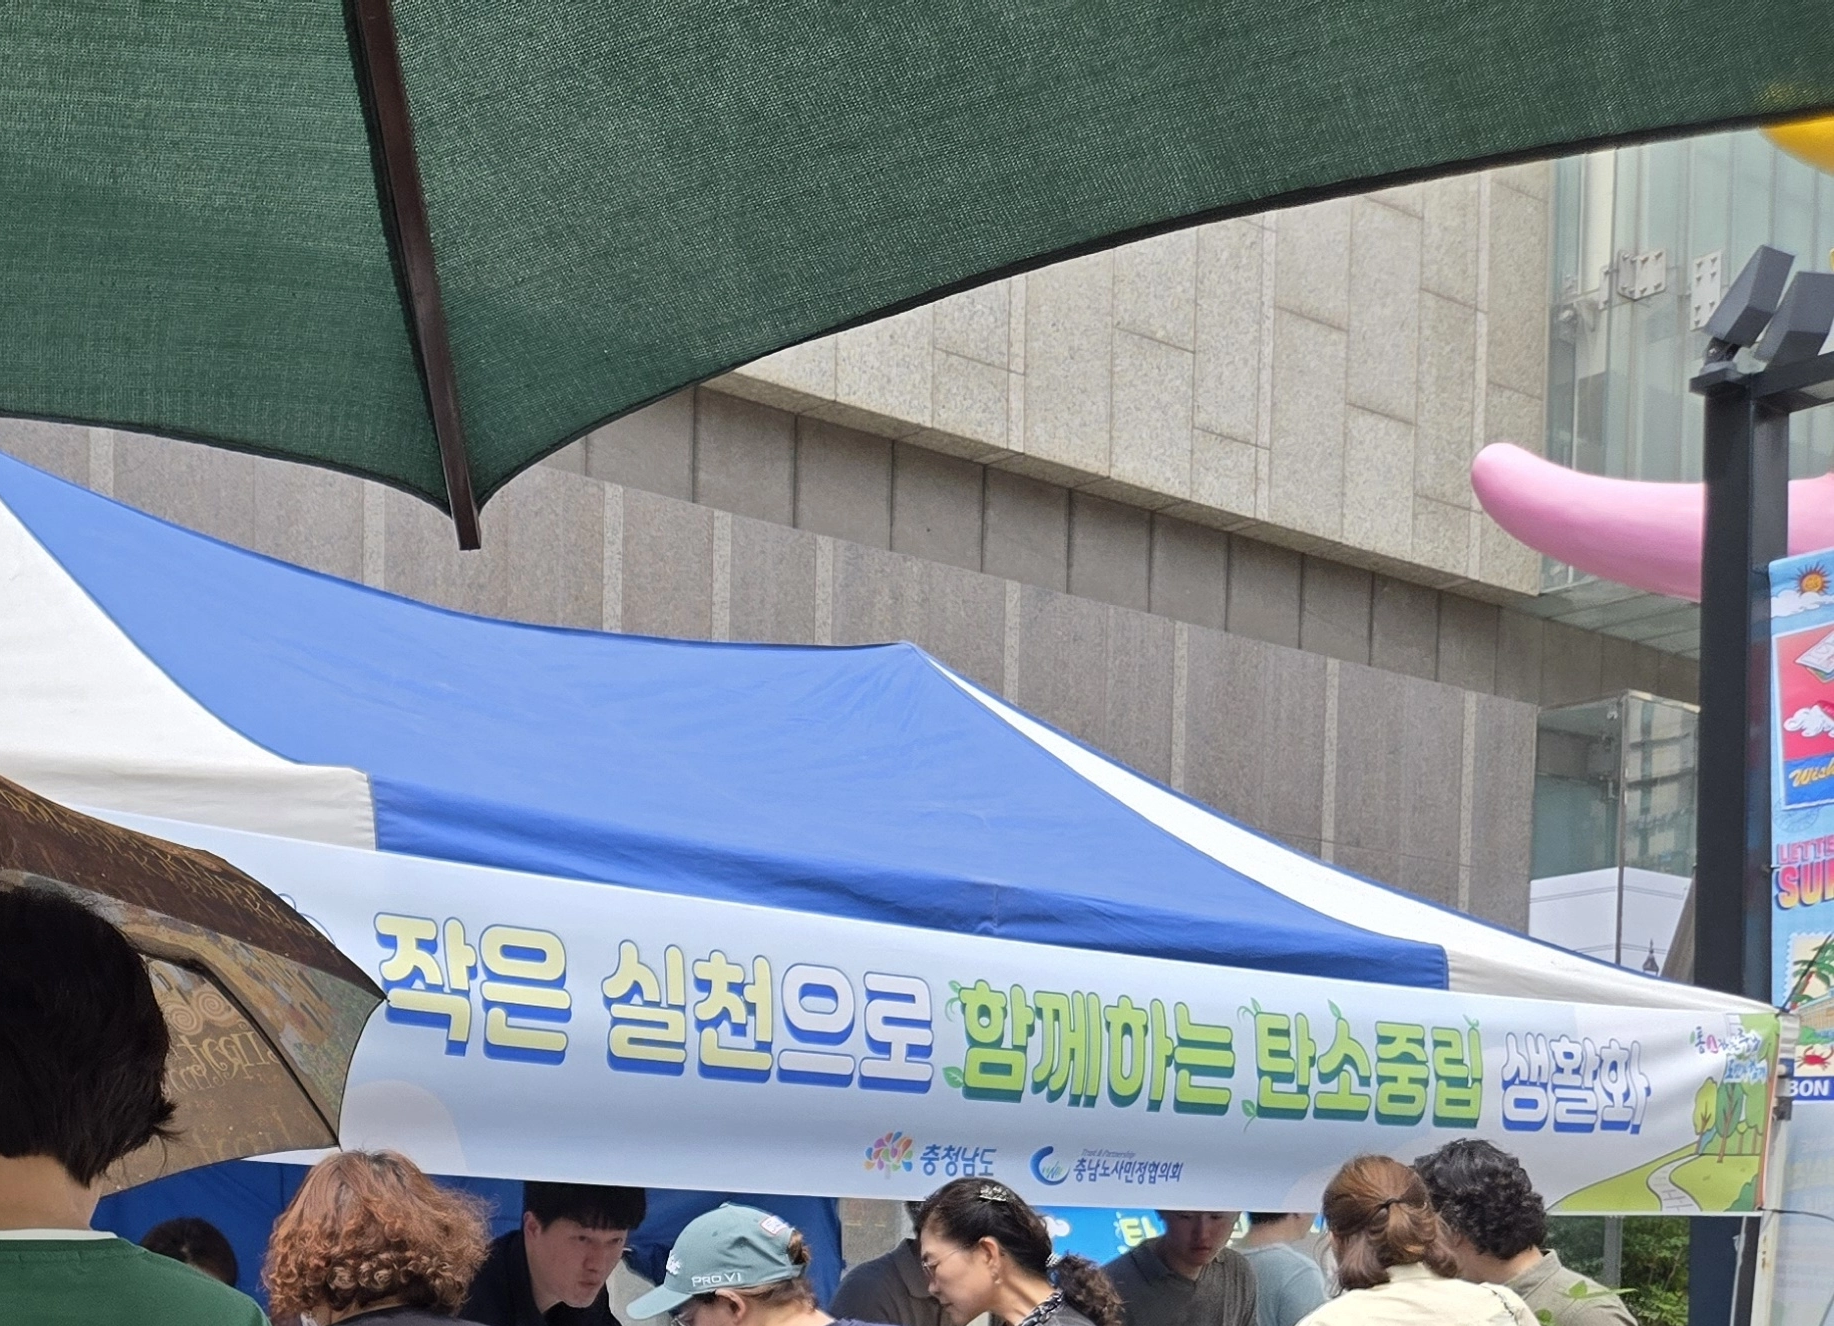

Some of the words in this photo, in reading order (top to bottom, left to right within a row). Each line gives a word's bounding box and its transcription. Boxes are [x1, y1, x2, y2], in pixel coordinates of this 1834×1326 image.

[373, 911, 575, 1066] 작은
[601, 938, 934, 1093] 실천으로
[958, 978, 1236, 1114] 함께하는
[1252, 1008, 1486, 1129] 탄소중립
[1499, 1030, 1651, 1135] 생활화
[919, 1143, 998, 1178] 충청남도
[1072, 1158, 1184, 1184] 충남노사민정협의회
[691, 1275, 722, 1288] PRO
